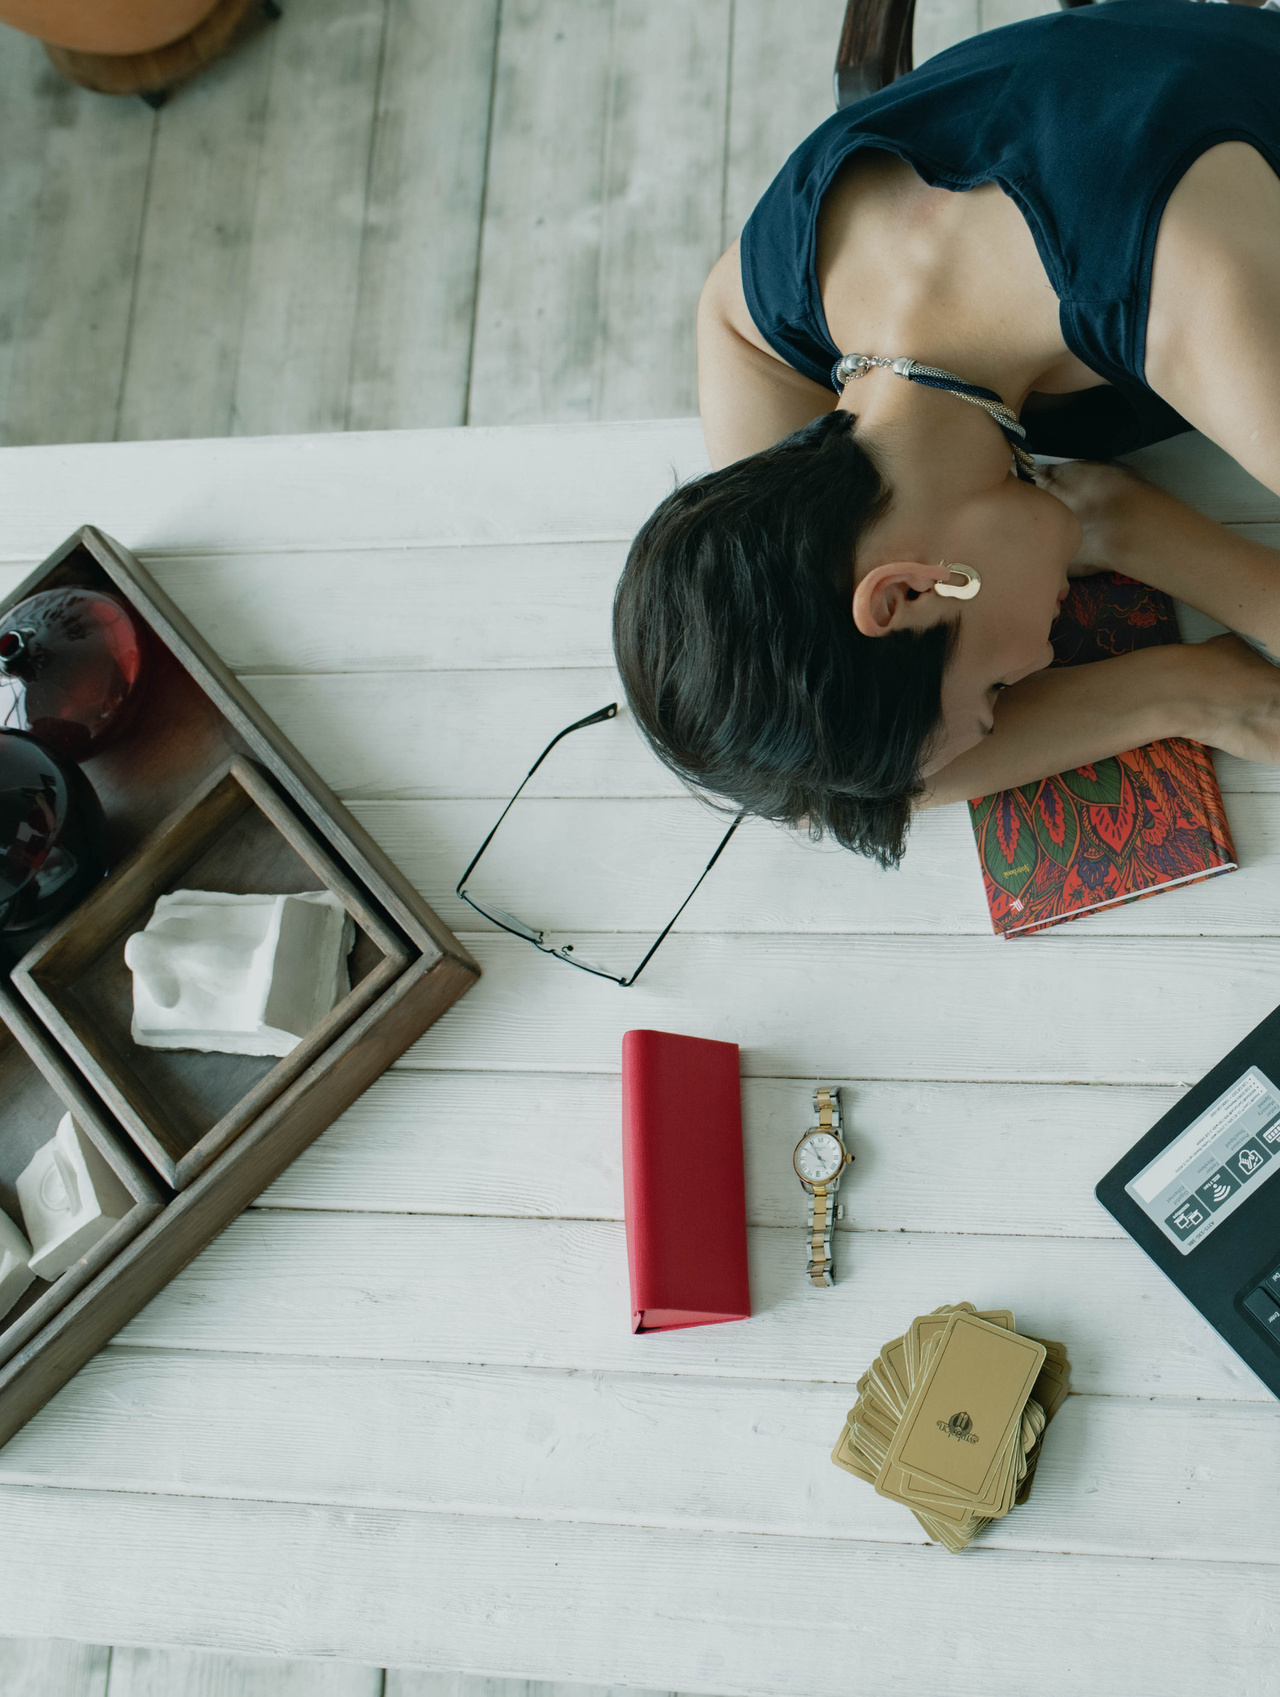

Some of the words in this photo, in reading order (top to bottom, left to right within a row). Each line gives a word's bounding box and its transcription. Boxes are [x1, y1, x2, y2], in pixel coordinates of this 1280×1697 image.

[1256, 1094, 1271, 1109] Speed
[1256, 1098, 1275, 1117] Memory
[1265, 1103, 1280, 1117] Faster
[1224, 1127, 1245, 1148] Touchpad
[1229, 1132, 1249, 1151] Precision
[1196, 1156, 1215, 1174] Wireless
[1205, 1161, 1219, 1175] Faster
[1165, 1185, 1185, 1203] Ethernet
[1172, 1189, 1189, 1205] Gigabit
[1268, 1311, 1280, 1323] Enter
